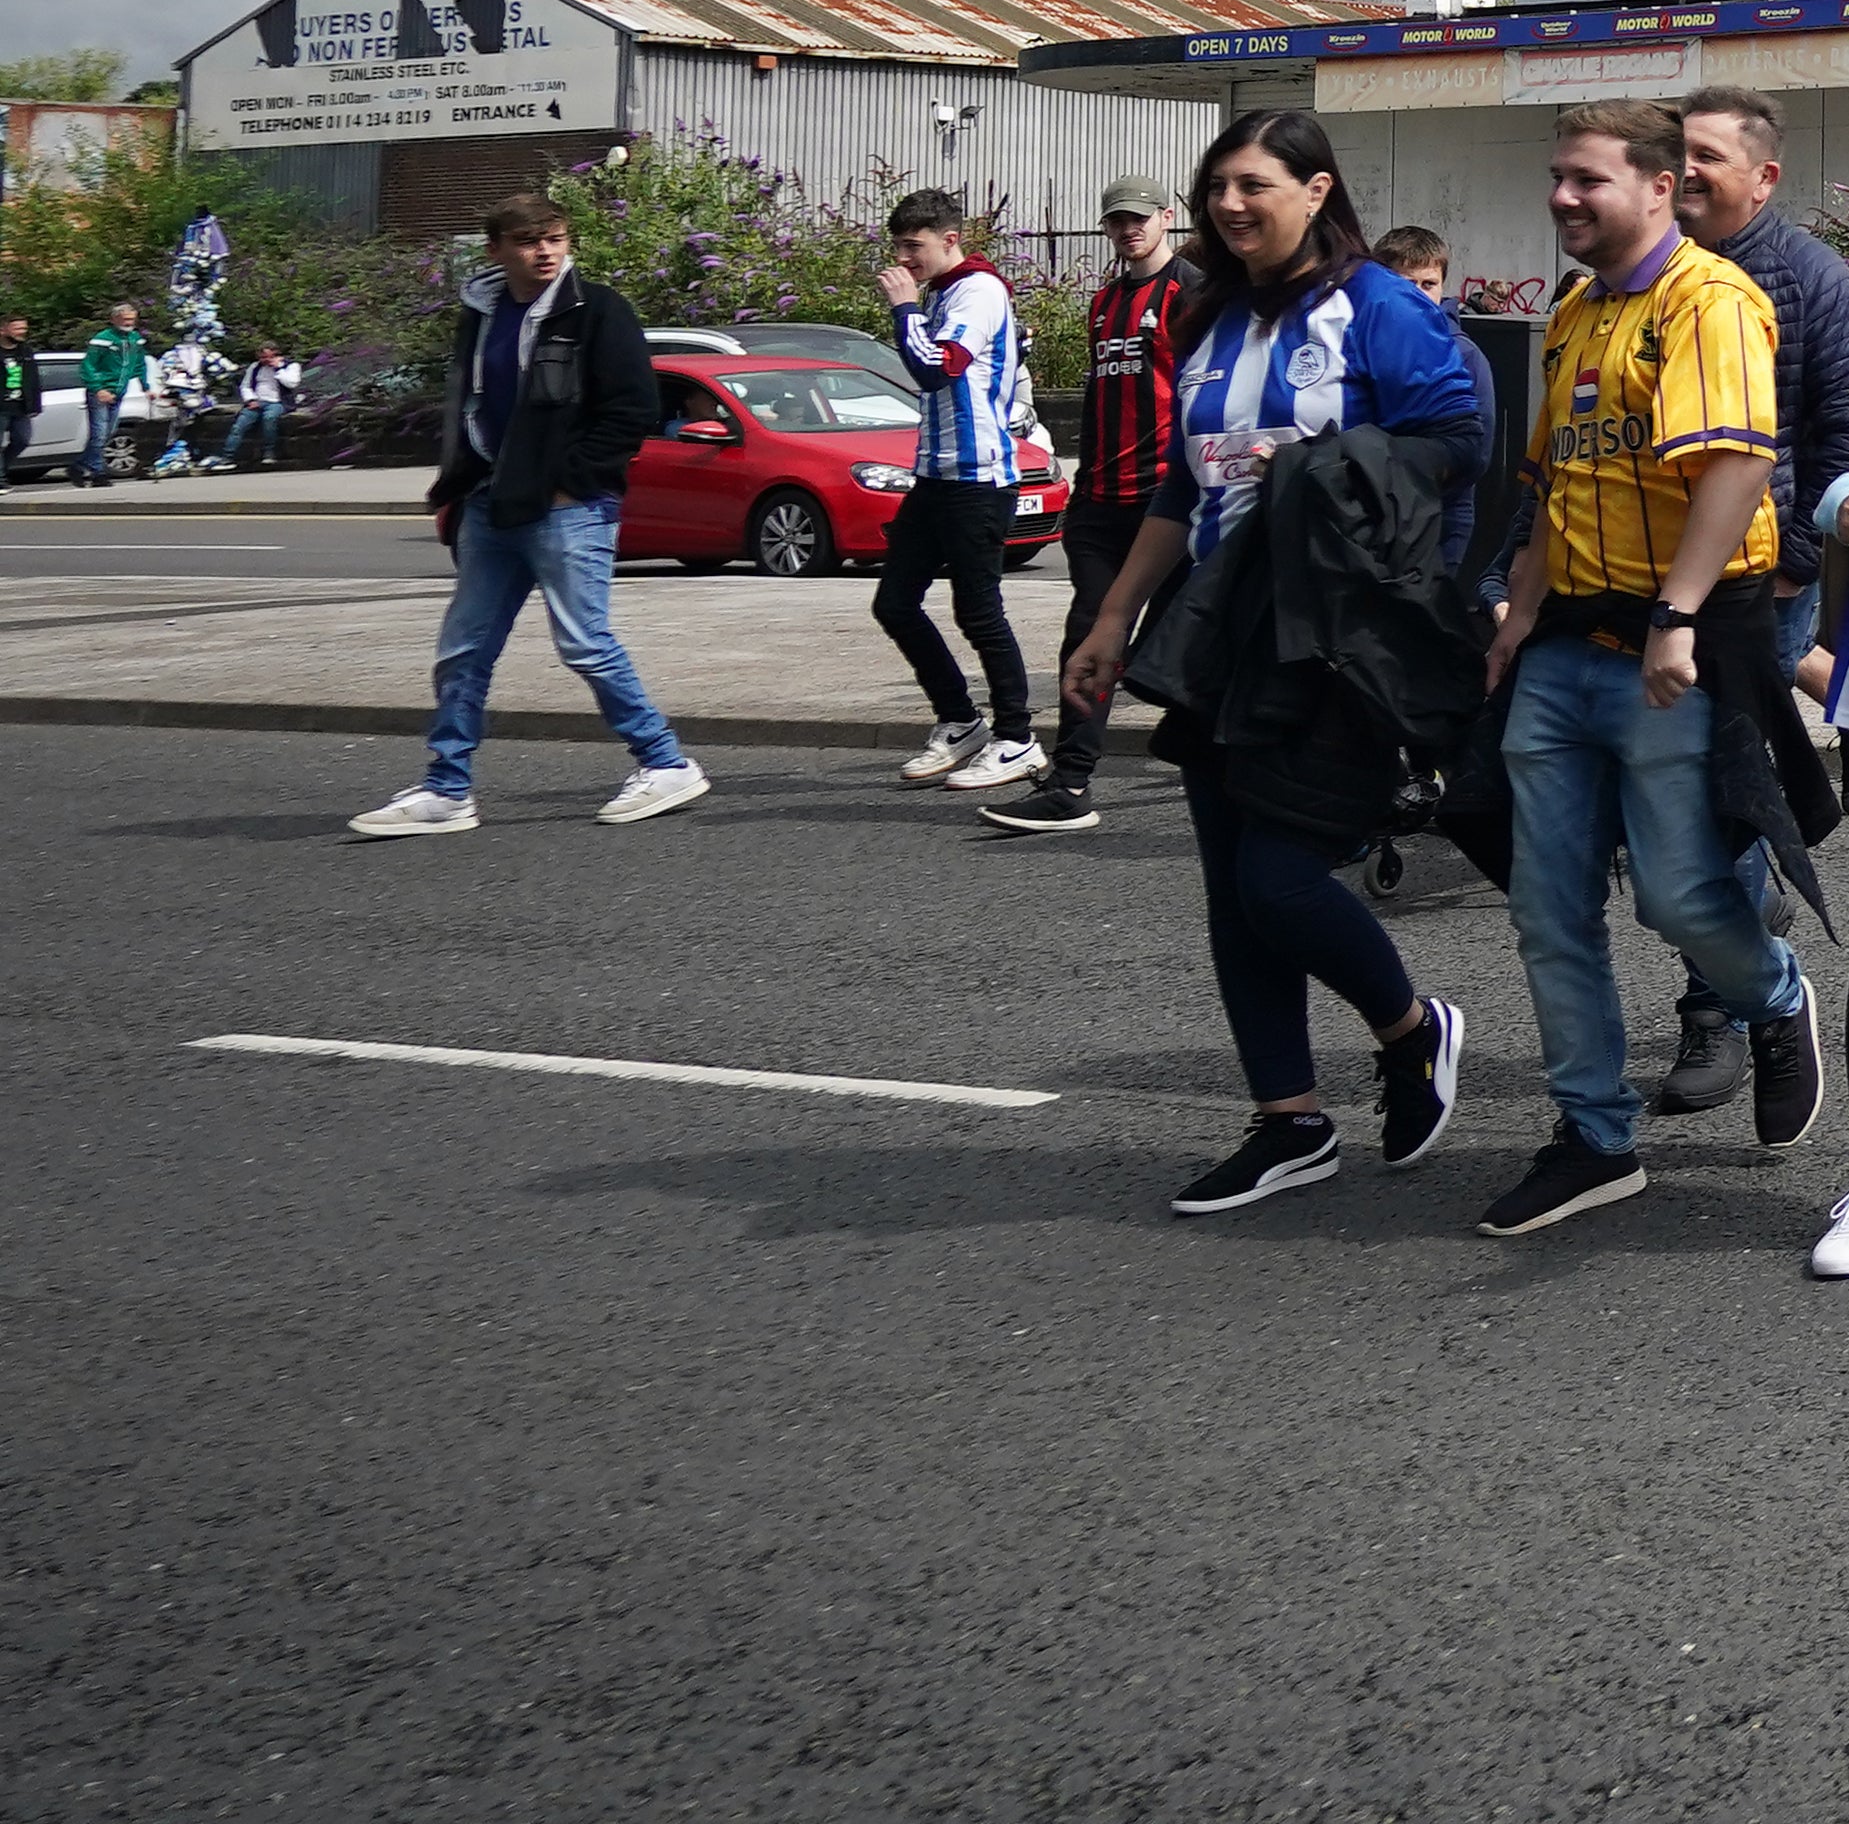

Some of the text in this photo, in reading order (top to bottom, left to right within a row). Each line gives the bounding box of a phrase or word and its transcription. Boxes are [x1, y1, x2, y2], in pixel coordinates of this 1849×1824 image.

[299, 12, 372, 38] UYERS
[1616, 12, 1716, 32] MOTOR WORLD
[1188, 35, 1289, 56] OPEN 7 DAYS
[1401, 26, 1497, 44] MOTOR WORLD
[308, 41, 354, 62] NON
[329, 66, 394, 83] STAINLESS
[397, 63, 437, 78] STEEL
[230, 99, 263, 113] OPEN
[435, 87, 459, 100] SAT
[240, 117, 323, 134] TELEPHONE
[452, 103, 538, 123] ENTRANCE
